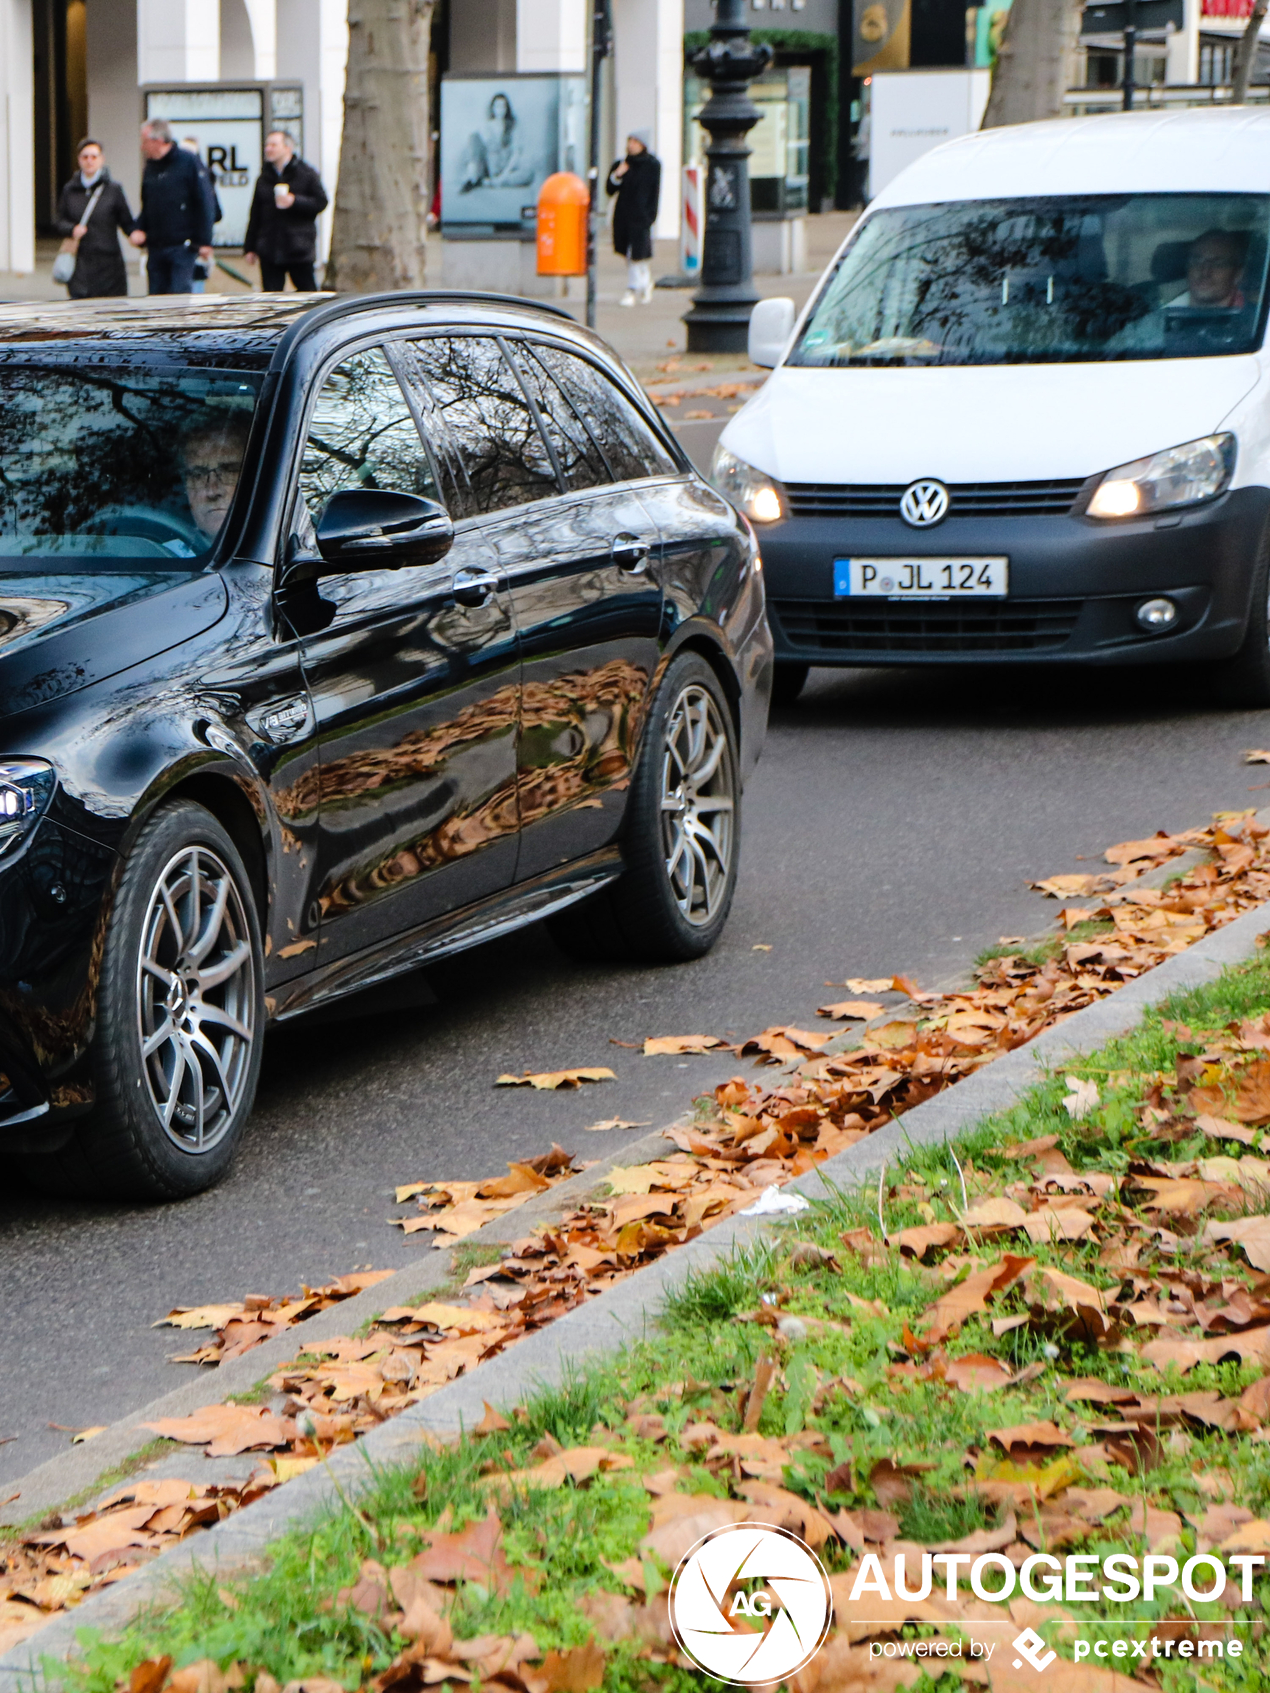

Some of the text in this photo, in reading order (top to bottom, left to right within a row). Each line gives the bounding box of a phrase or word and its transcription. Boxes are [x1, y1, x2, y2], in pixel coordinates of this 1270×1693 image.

[207, 146, 248, 171] RL
[861, 564, 992, 590] P JL 124
